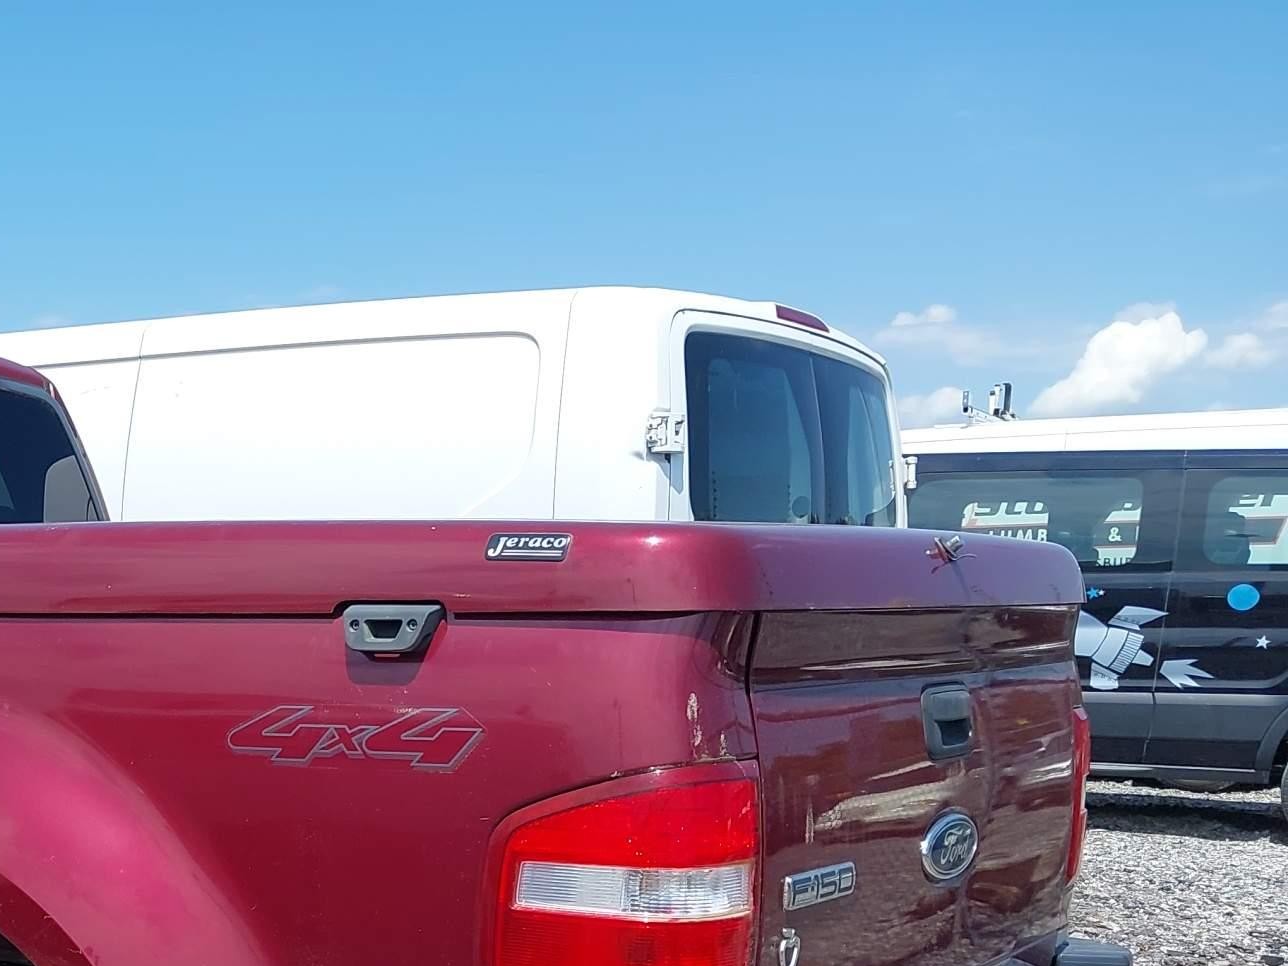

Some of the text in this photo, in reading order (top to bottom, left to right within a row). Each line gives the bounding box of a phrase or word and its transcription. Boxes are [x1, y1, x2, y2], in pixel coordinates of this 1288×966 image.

[487, 534, 568, 557] Jeraco
[1108, 526, 1122, 542] &
[226, 705, 486, 771] 4x4
